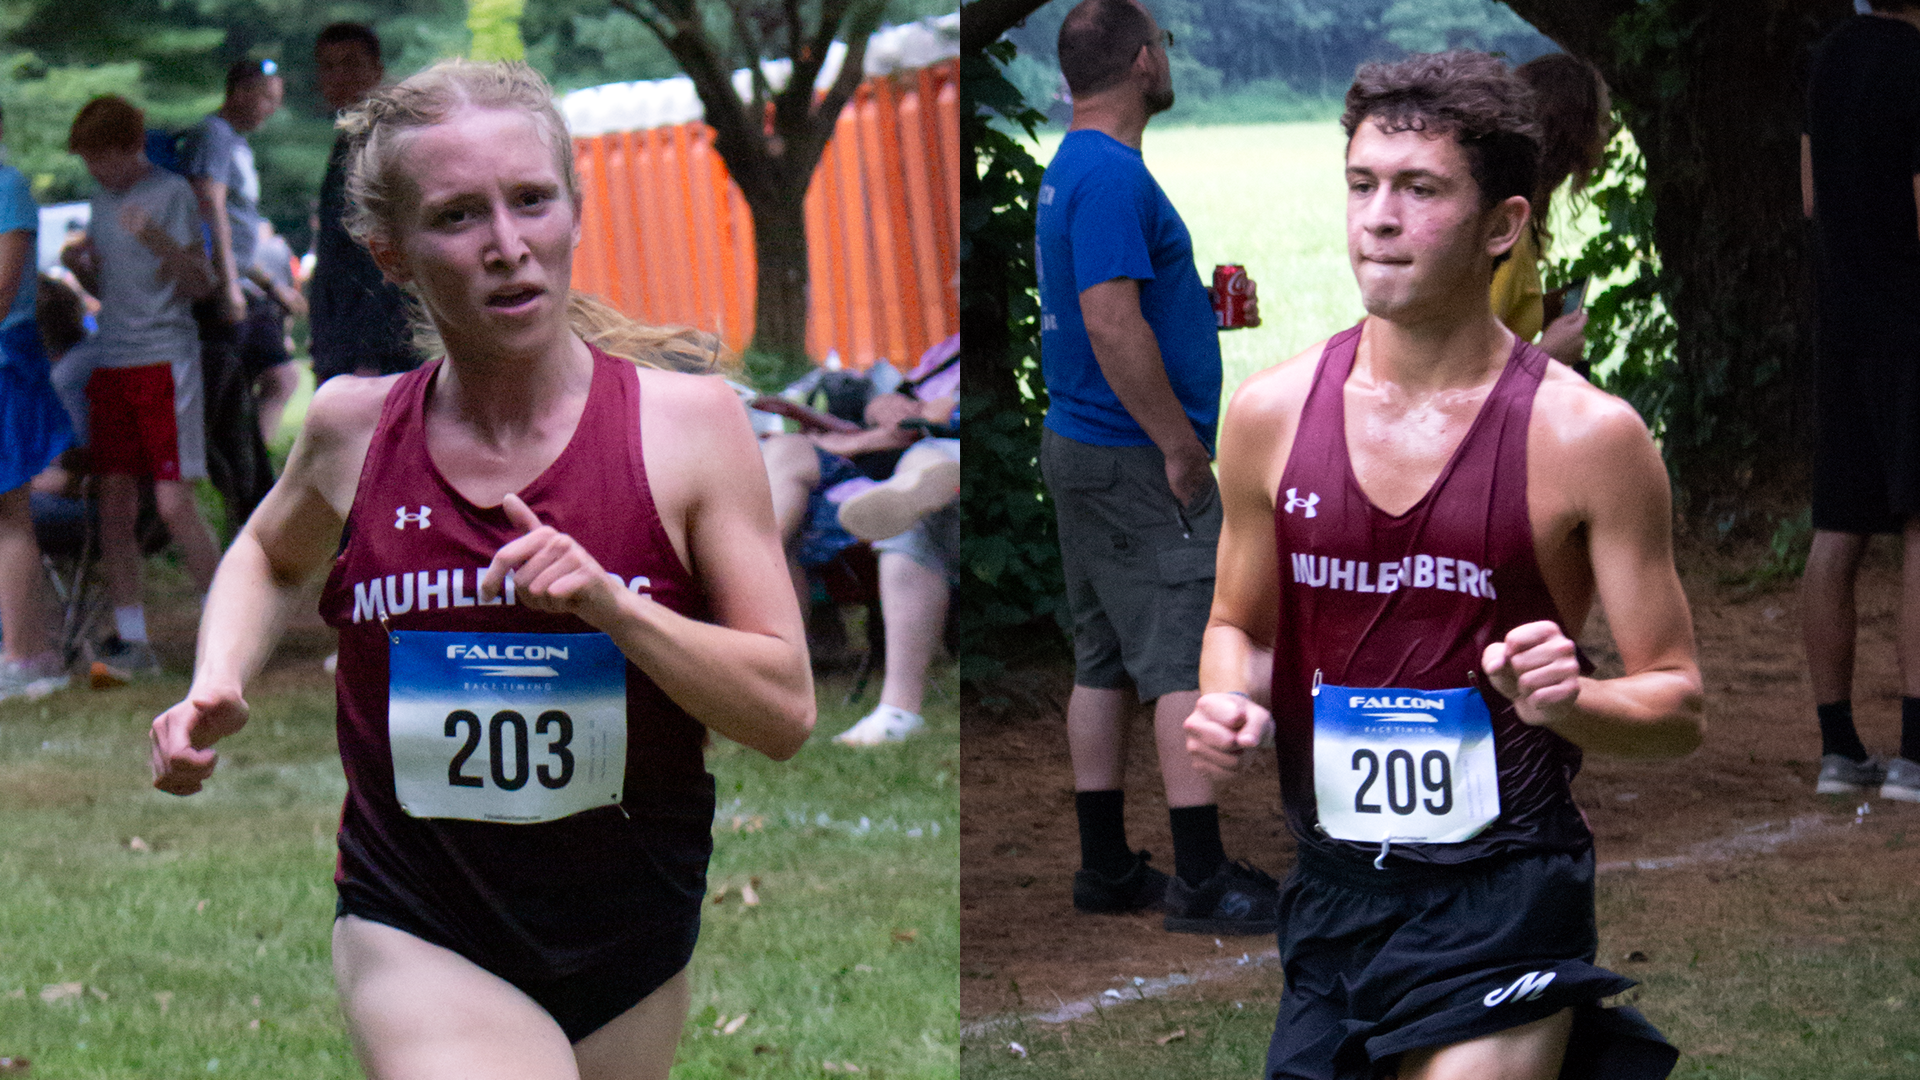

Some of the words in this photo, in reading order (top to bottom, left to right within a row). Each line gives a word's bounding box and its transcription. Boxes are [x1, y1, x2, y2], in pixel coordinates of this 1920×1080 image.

[446, 644, 569, 660] FALCON
[1349, 696, 1445, 710] FALCON
[443, 709, 575, 792] 203
[1351, 748, 1454, 816] 209
